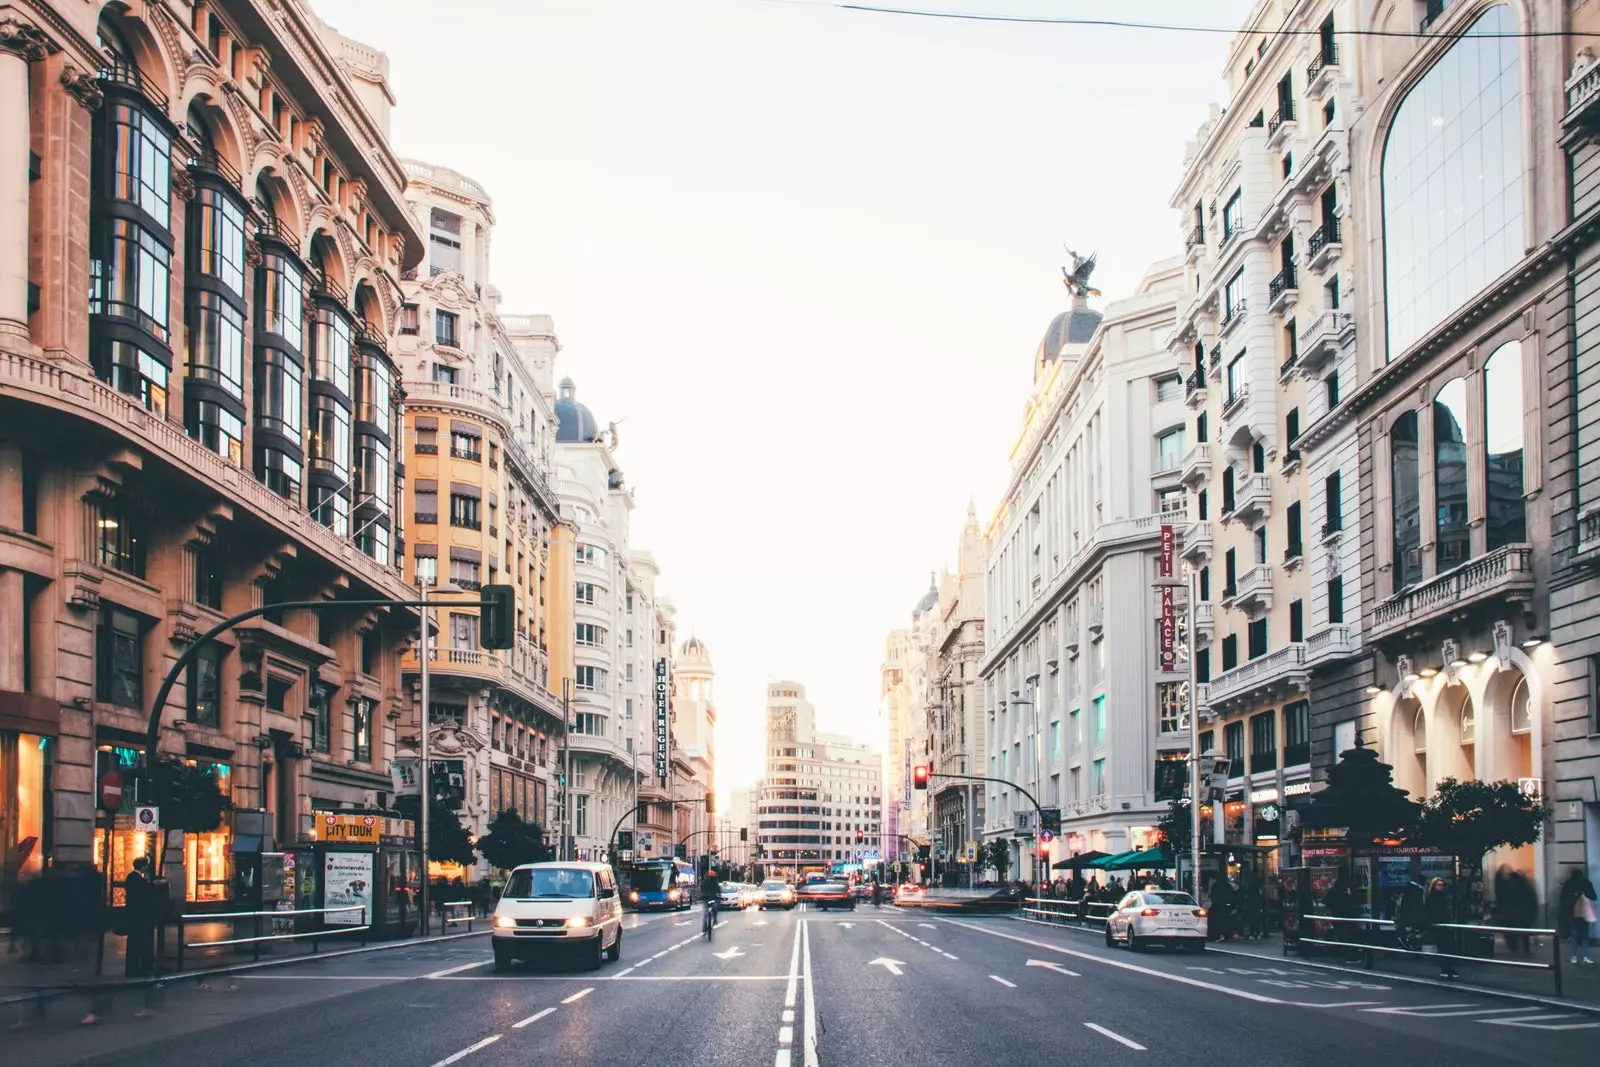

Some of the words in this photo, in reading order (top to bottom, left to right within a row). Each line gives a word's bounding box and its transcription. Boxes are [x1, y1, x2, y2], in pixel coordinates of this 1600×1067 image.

[1163, 587, 1172, 648] PALACE
[657, 675, 666, 715] HOTEL
[657, 720, 666, 776] REGENTE
[1284, 782, 1311, 796] STARBUCK
[326, 825, 346, 837] CITY
[348, 825, 373, 837] TOUR
[1256, 979, 1392, 990] BUS
